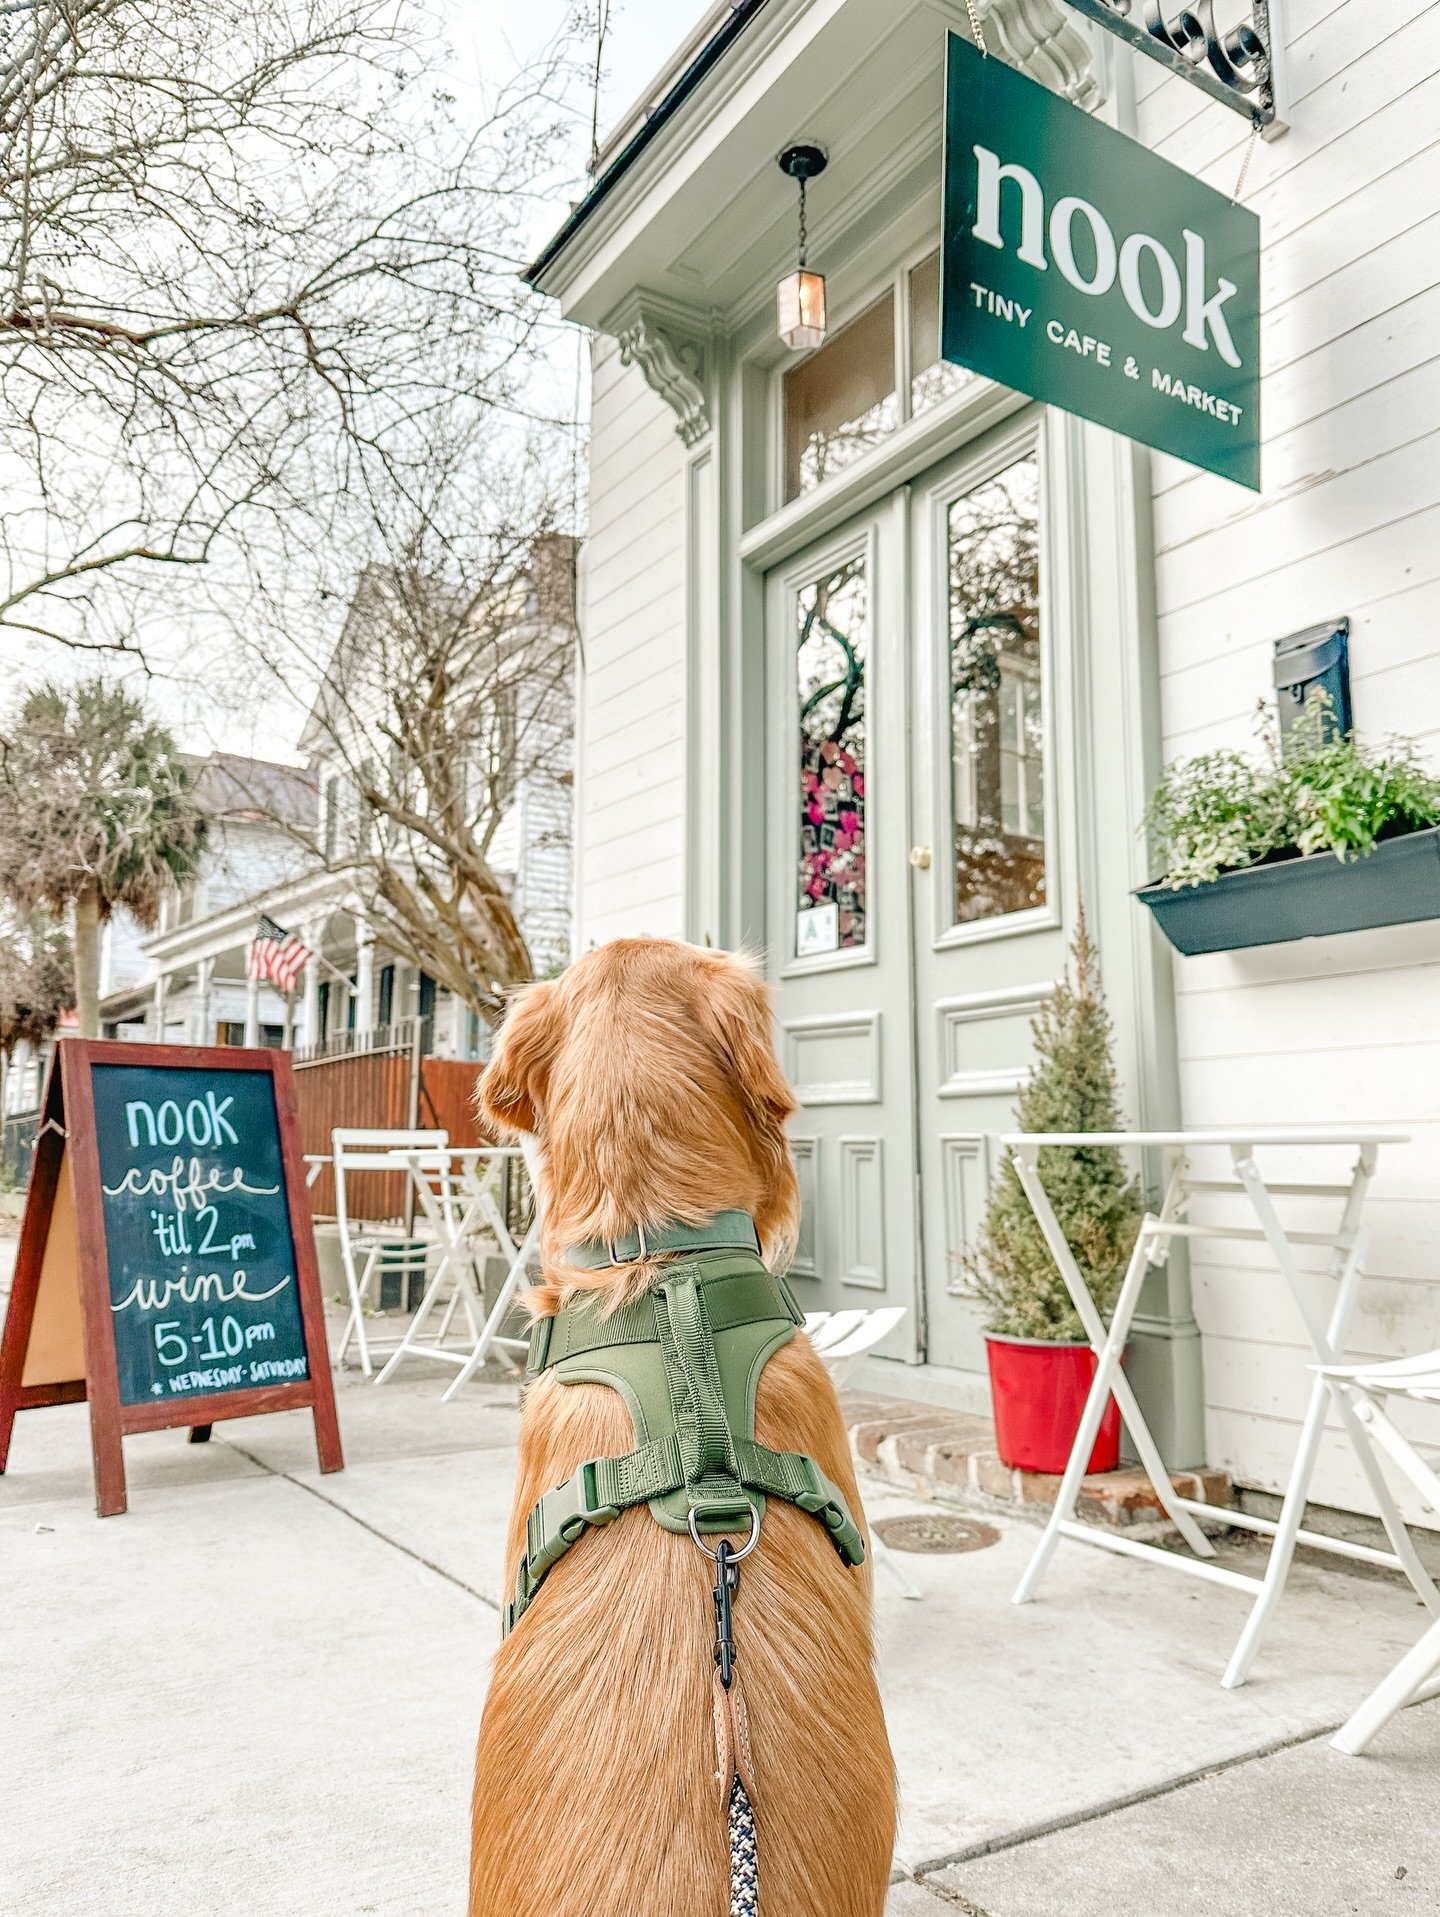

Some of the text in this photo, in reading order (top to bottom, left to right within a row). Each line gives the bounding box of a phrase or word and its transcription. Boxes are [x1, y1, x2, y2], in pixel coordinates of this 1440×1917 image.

[971, 144, 1243, 369] nook
[970, 283, 1243, 426] TINY CAFE & MARKET
[125, 1090, 239, 1148] nook
[102, 1156, 280, 1212] coffee
[110, 1265, 290, 1312] wine
